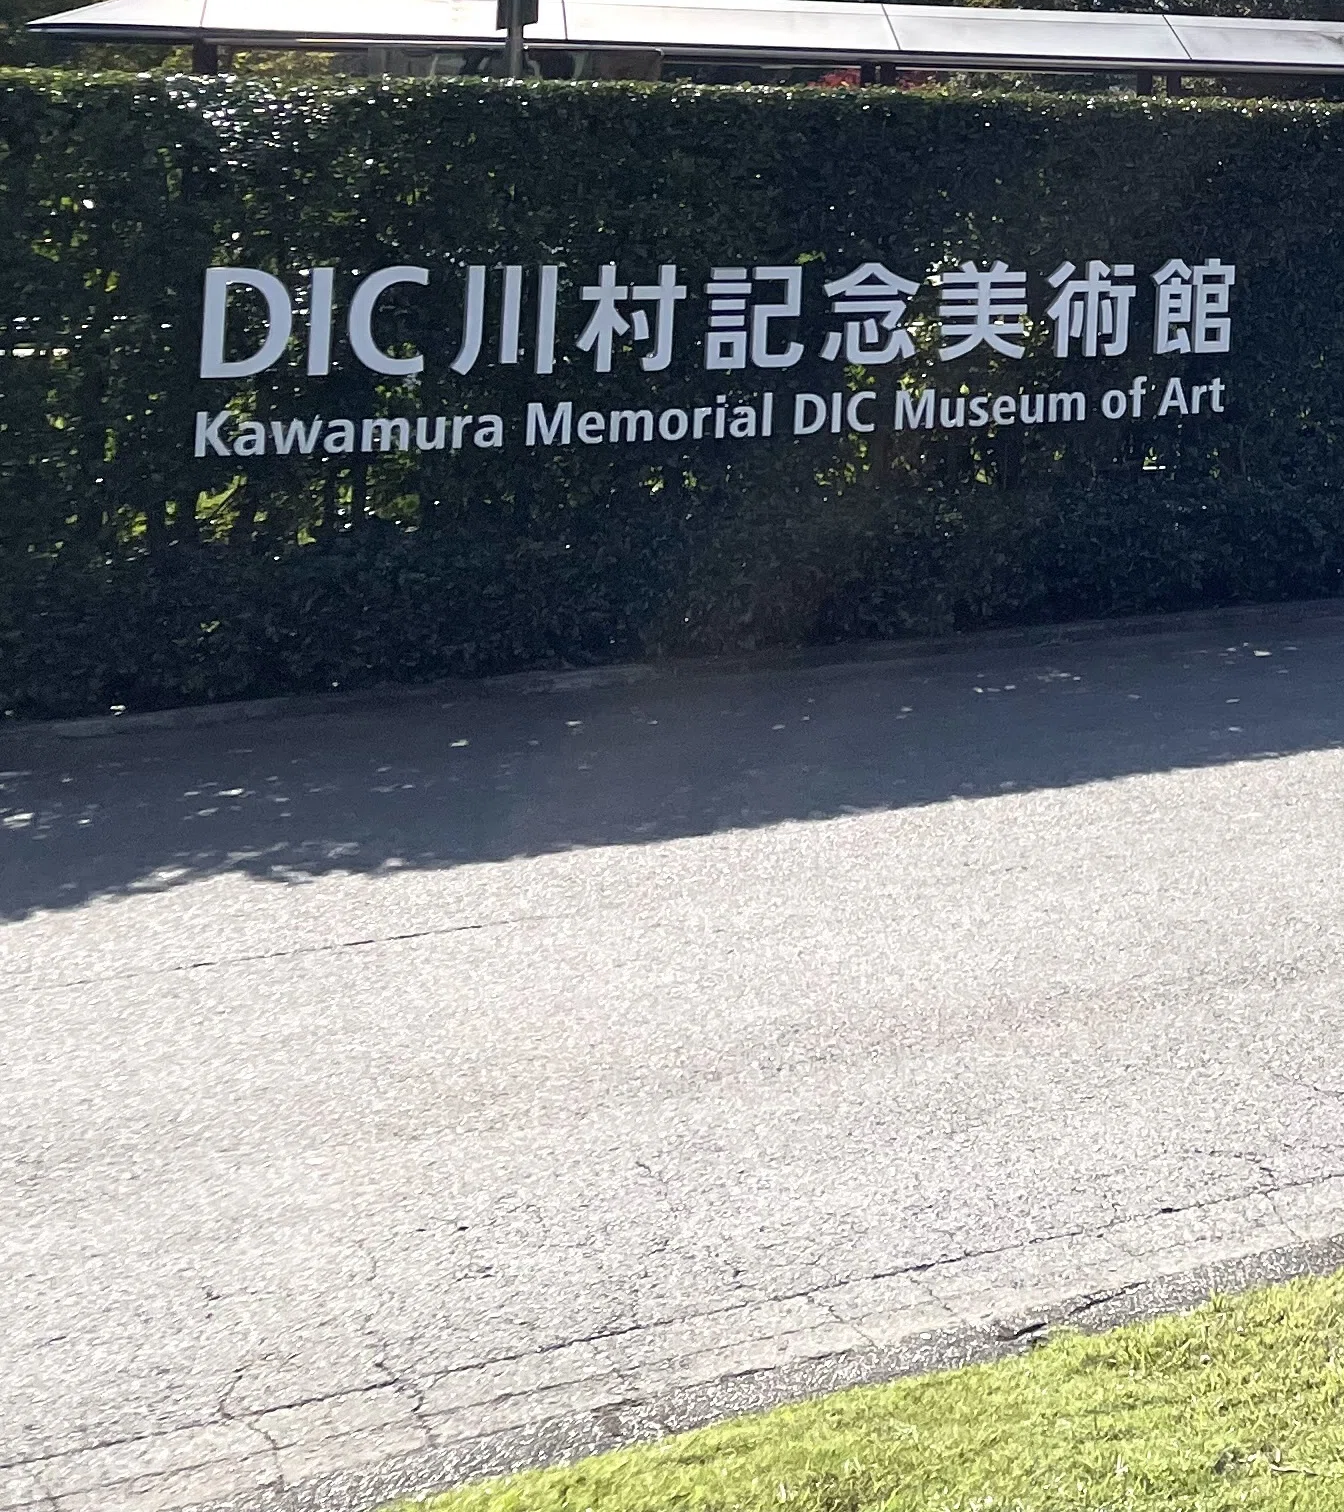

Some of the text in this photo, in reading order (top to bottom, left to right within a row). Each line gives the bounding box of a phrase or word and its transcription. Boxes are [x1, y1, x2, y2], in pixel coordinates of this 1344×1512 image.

[200, 258, 1237, 378] DIC川村記念美術館
[194, 376, 1226, 458] Kawamura Memorial DIC Museum of Art
